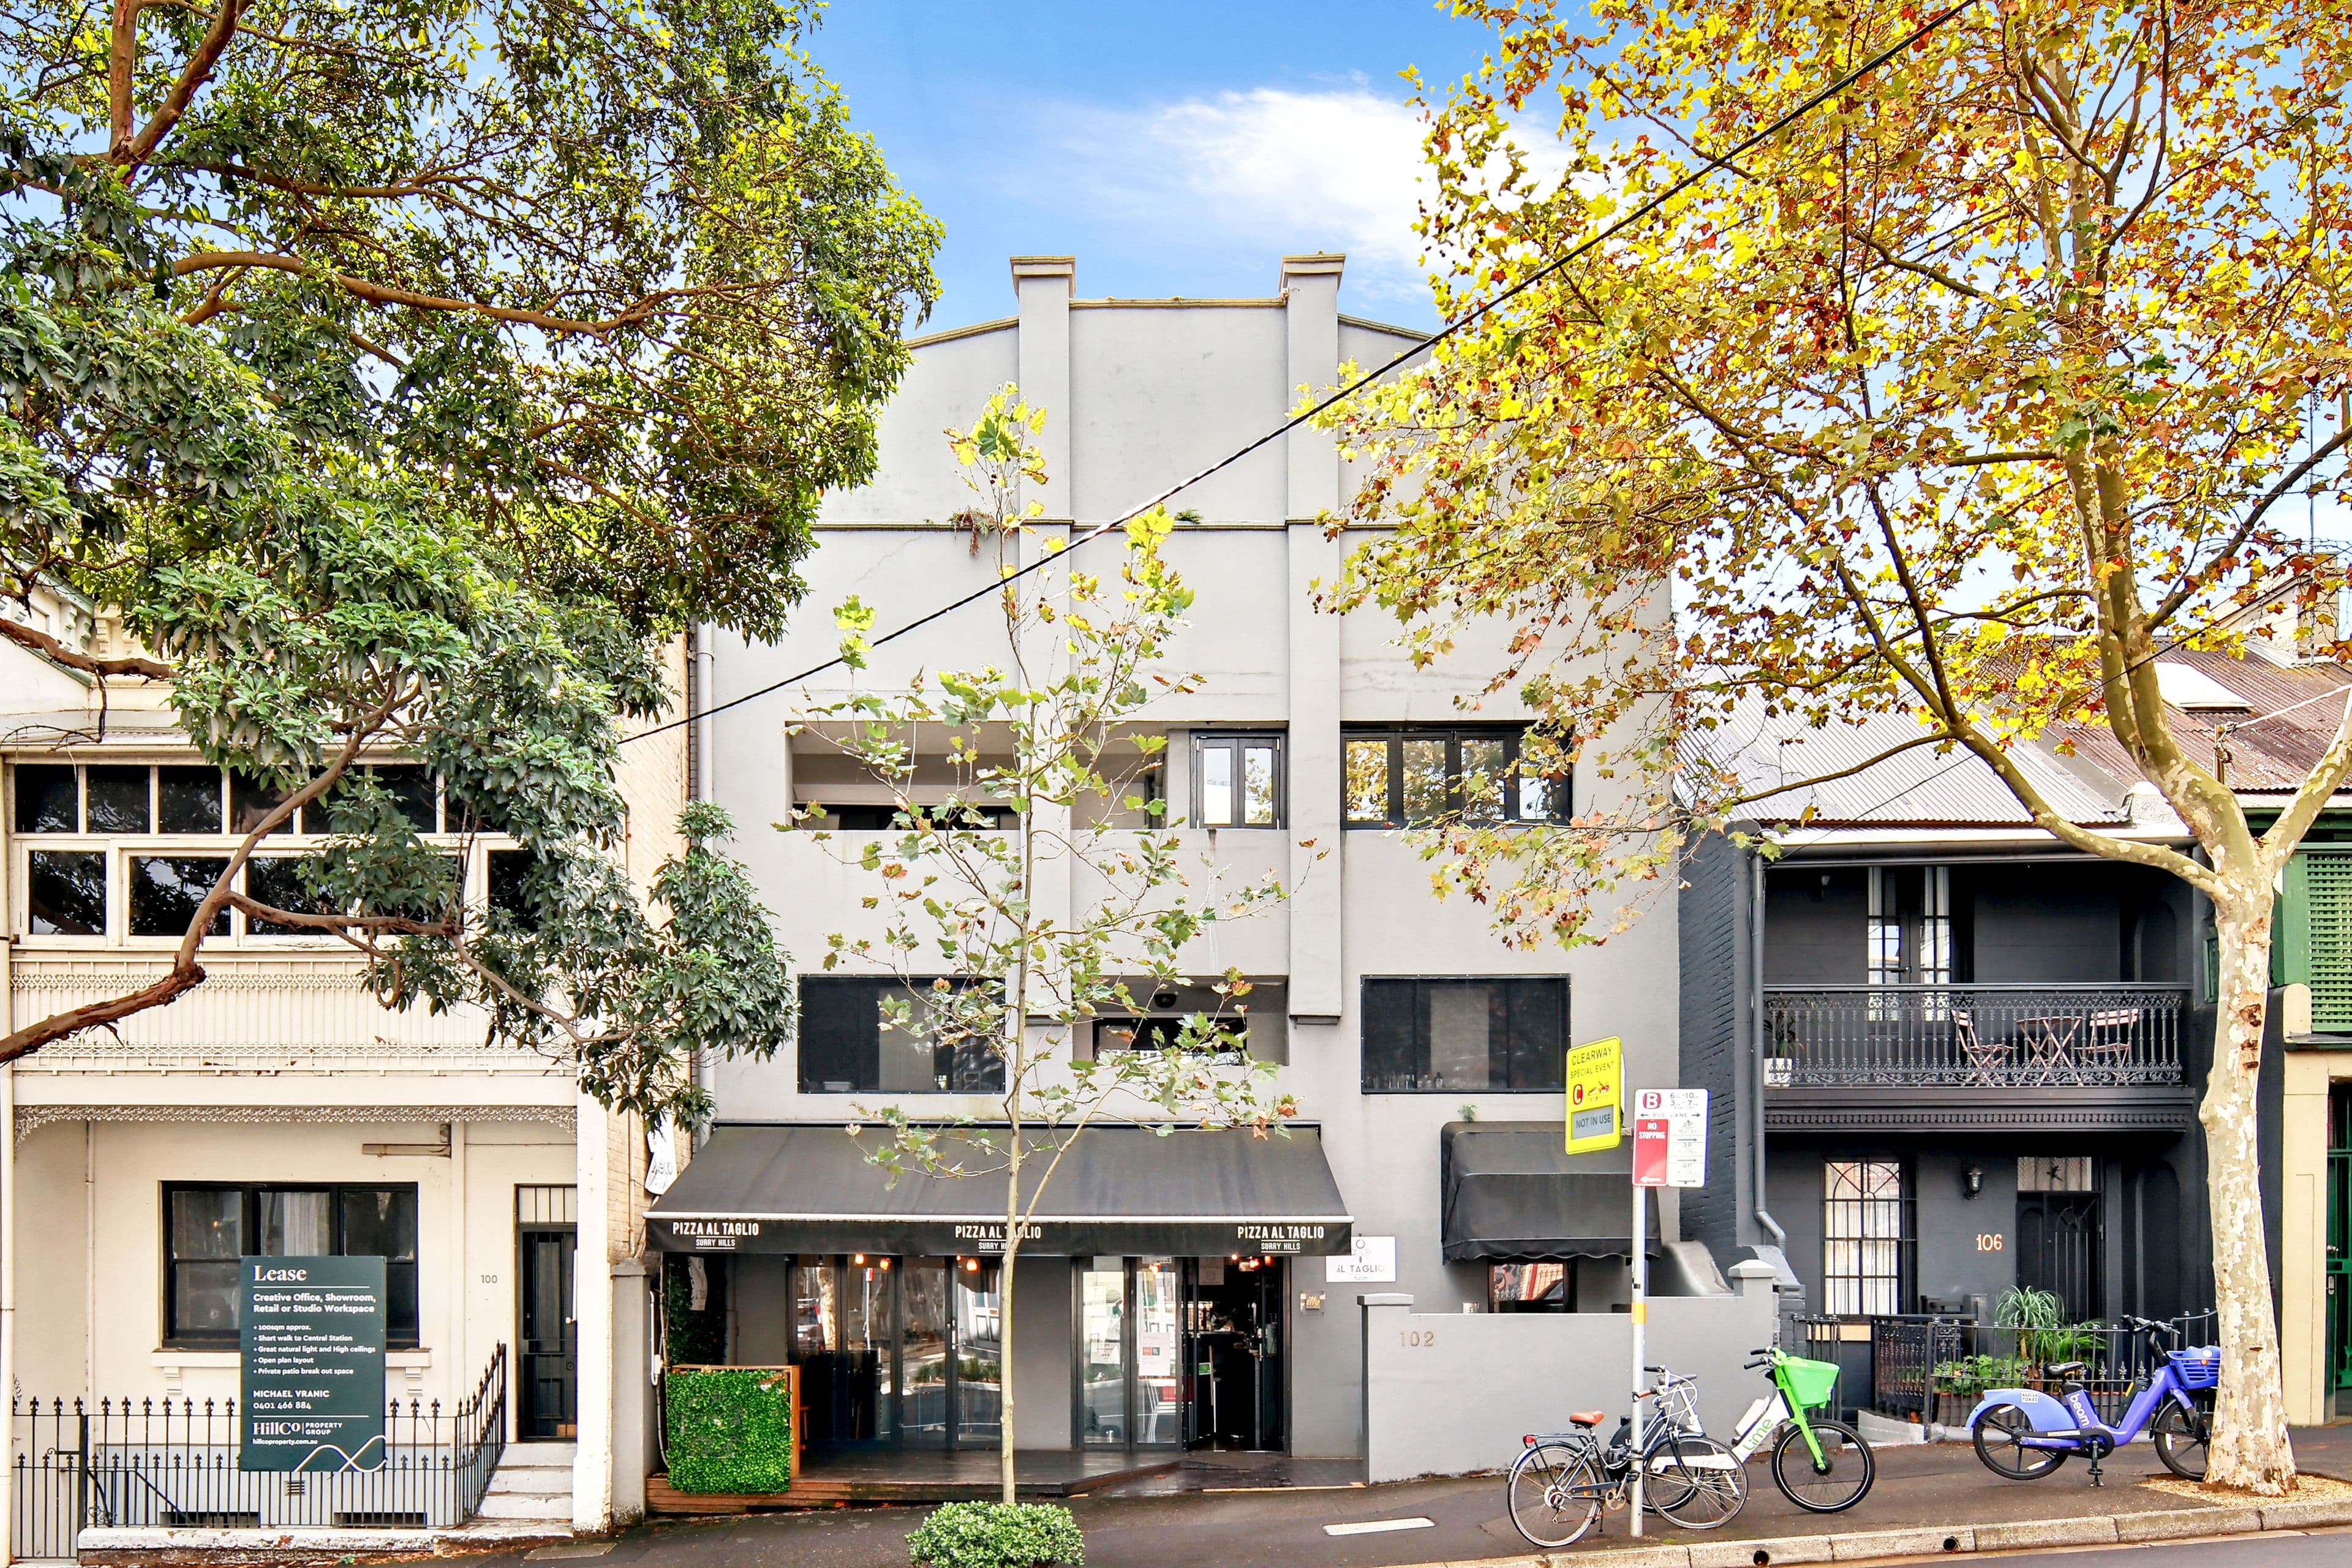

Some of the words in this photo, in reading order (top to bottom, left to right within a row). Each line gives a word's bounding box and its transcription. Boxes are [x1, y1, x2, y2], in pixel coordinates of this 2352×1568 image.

[1572, 1046, 1613, 1066] CLEARWAY
[1570, 1067, 1593, 1079] SPECIAL
[1595, 1061, 1614, 1072] EVENT
[1575, 1118, 1589, 1129] NOT
[1591, 1115, 1598, 1126] IN
[1599, 1114, 1611, 1125] USE
[1646, 1122, 1657, 1131] NO
[1638, 1131, 1667, 1139] STOPPING
[673, 1222, 704, 1235] PIZZA
[706, 1223, 720, 1235] AL
[722, 1223, 760, 1235] TAGLIO
[955, 1225, 986, 1238] PIZZA
[989, 1226, 1002, 1238] AL
[1237, 1226, 1269, 1239] PIZZA
[1271, 1226, 1285, 1239] AL
[1287, 1226, 1324, 1239] TAGLIO
[696, 1238, 716, 1247] SURRY
[718, 1238, 736, 1247] HILLS
[978, 1242, 999, 1250] SURRY
[1261, 1242, 1281, 1251] SURRY
[1283, 1242, 1300, 1251] HILLS
[1976, 1234, 2003, 1251] 106
[254, 1265, 307, 1281] Lease
[1336, 1264, 1346, 1273] AL
[1349, 1264, 1385, 1273] TAGLIO
[480, 1274, 498, 1284] 100
[253, 1293, 292, 1302] Creative
[293, 1292, 323, 1303] Office,
[325, 1293, 377, 1303] Showroom,
[254, 1304, 279, 1313] Retail
[293, 1304, 322, 1313] Studio
[324, 1304, 375, 1314] Workspace
[1401, 1330, 1434, 1347] 102
[302, 1345, 318, 1354] light
[350, 1345, 375, 1354] ceilings
[277, 1401, 293, 1410] 466
[295, 1401, 312, 1410] 884
[2070, 1393, 2090, 1427] beam
[253, 1422, 301, 1435] HillCo
[1742, 1419, 1774, 1451] Lime
